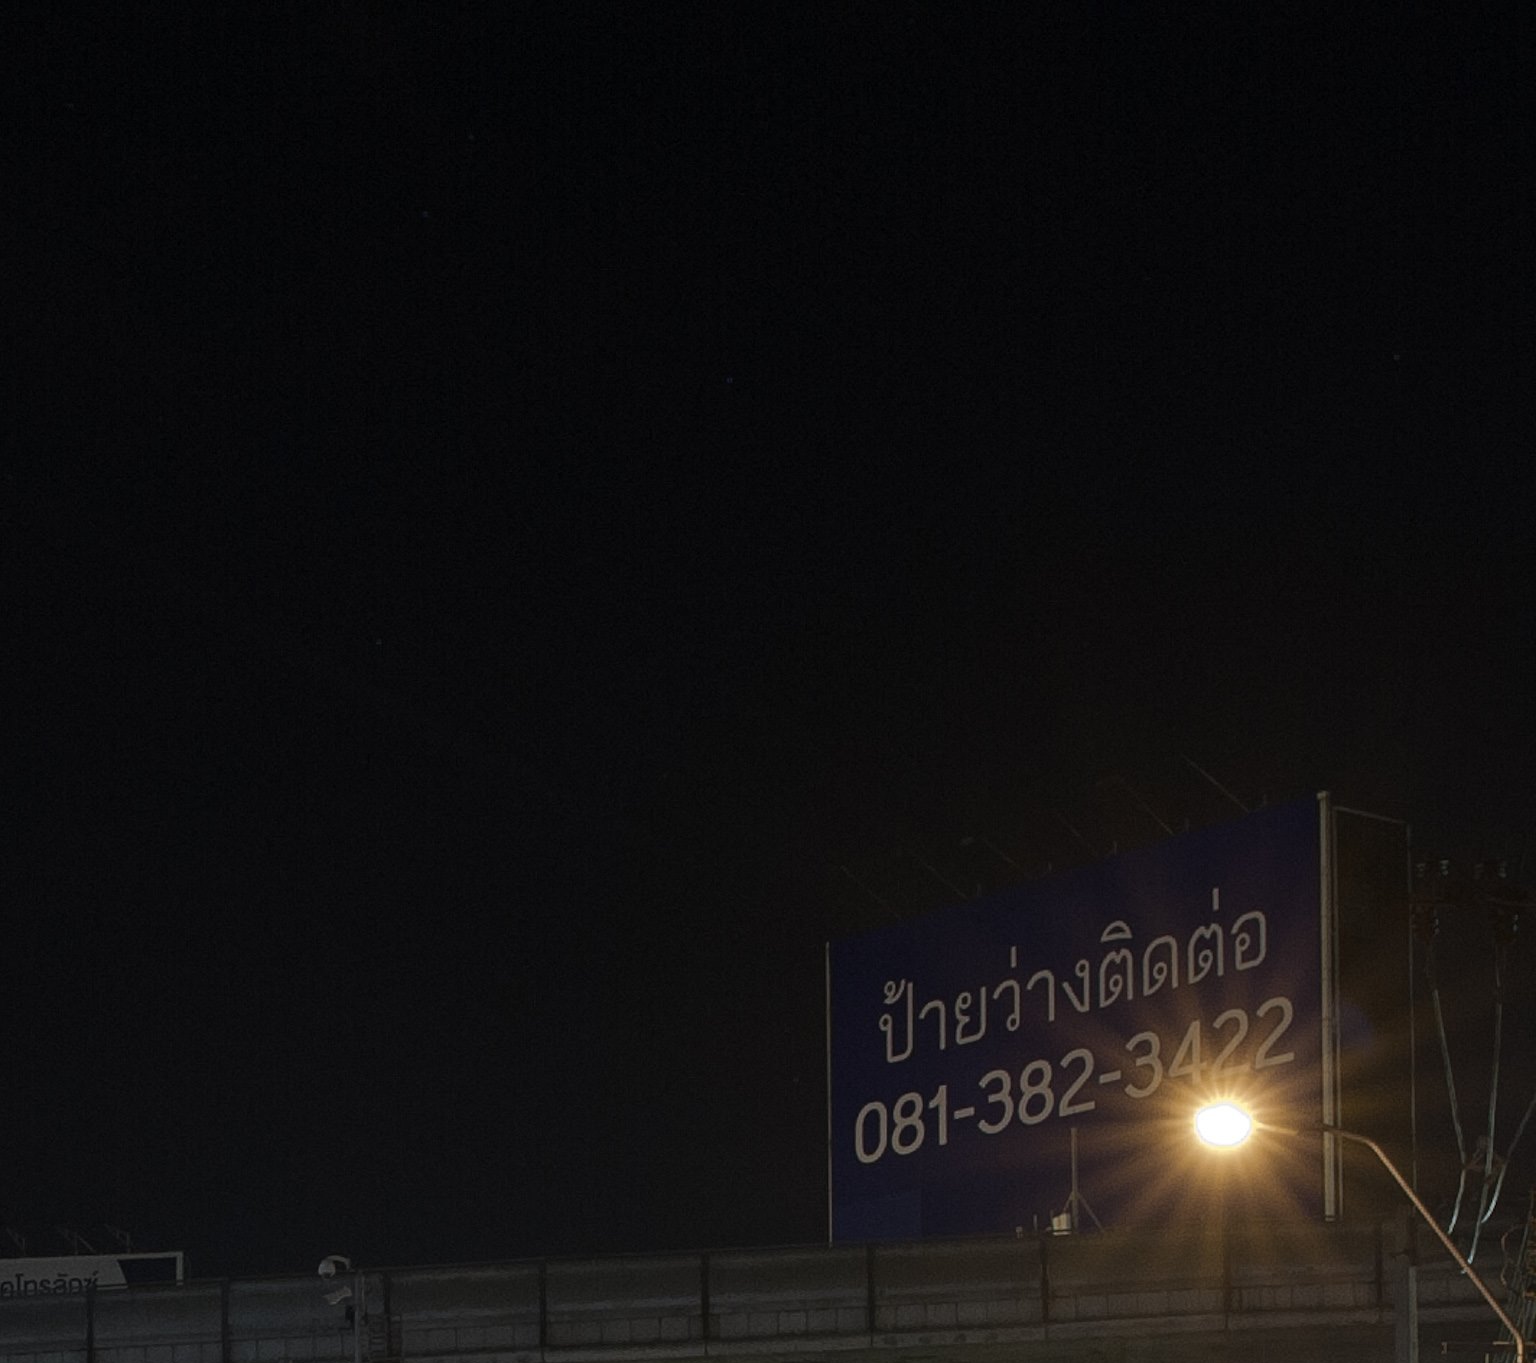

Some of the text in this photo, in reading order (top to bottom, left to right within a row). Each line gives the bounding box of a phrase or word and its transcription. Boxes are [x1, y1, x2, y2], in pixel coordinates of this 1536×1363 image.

[878, 887, 1267, 1064] ป้ายว่างติดต่อ
[854, 996, 1296, 1165] 081-382-3422
